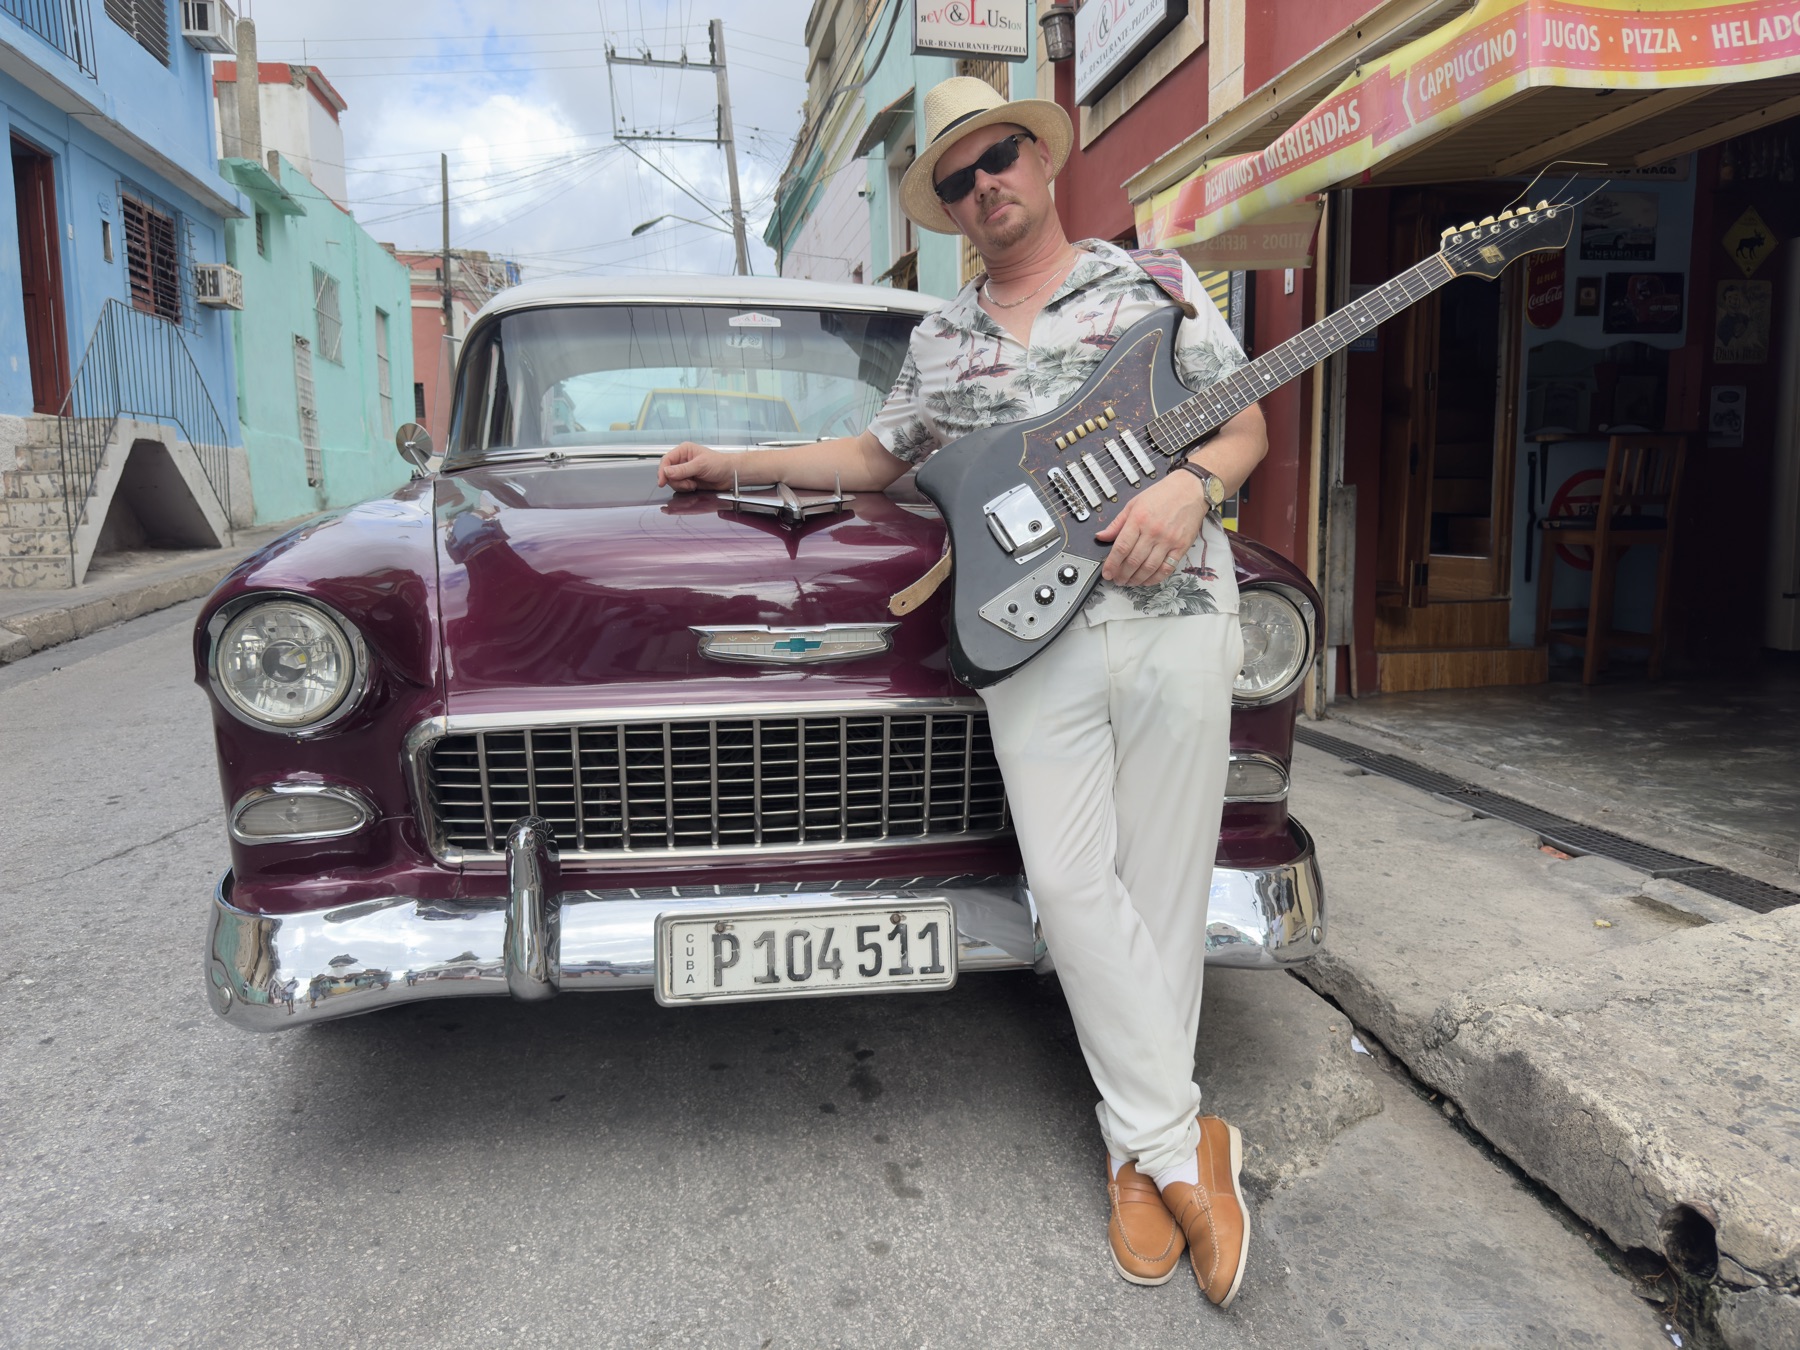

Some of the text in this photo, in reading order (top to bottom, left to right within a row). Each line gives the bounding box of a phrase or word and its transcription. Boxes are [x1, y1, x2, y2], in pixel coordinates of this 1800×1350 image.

[1418, 28, 1517, 101] CAPPUCCINO
[1542, 19, 1600, 51] JUGOS
[1621, 28, 1682, 54] PIZZA
[1205, 156, 1254, 206] DESAYUNOS
[1263, 98, 1361, 172] MERIENDAS
[1586, 250, 1653, 260] CHEVROLET
[685, 933, 695, 984] CUBA
